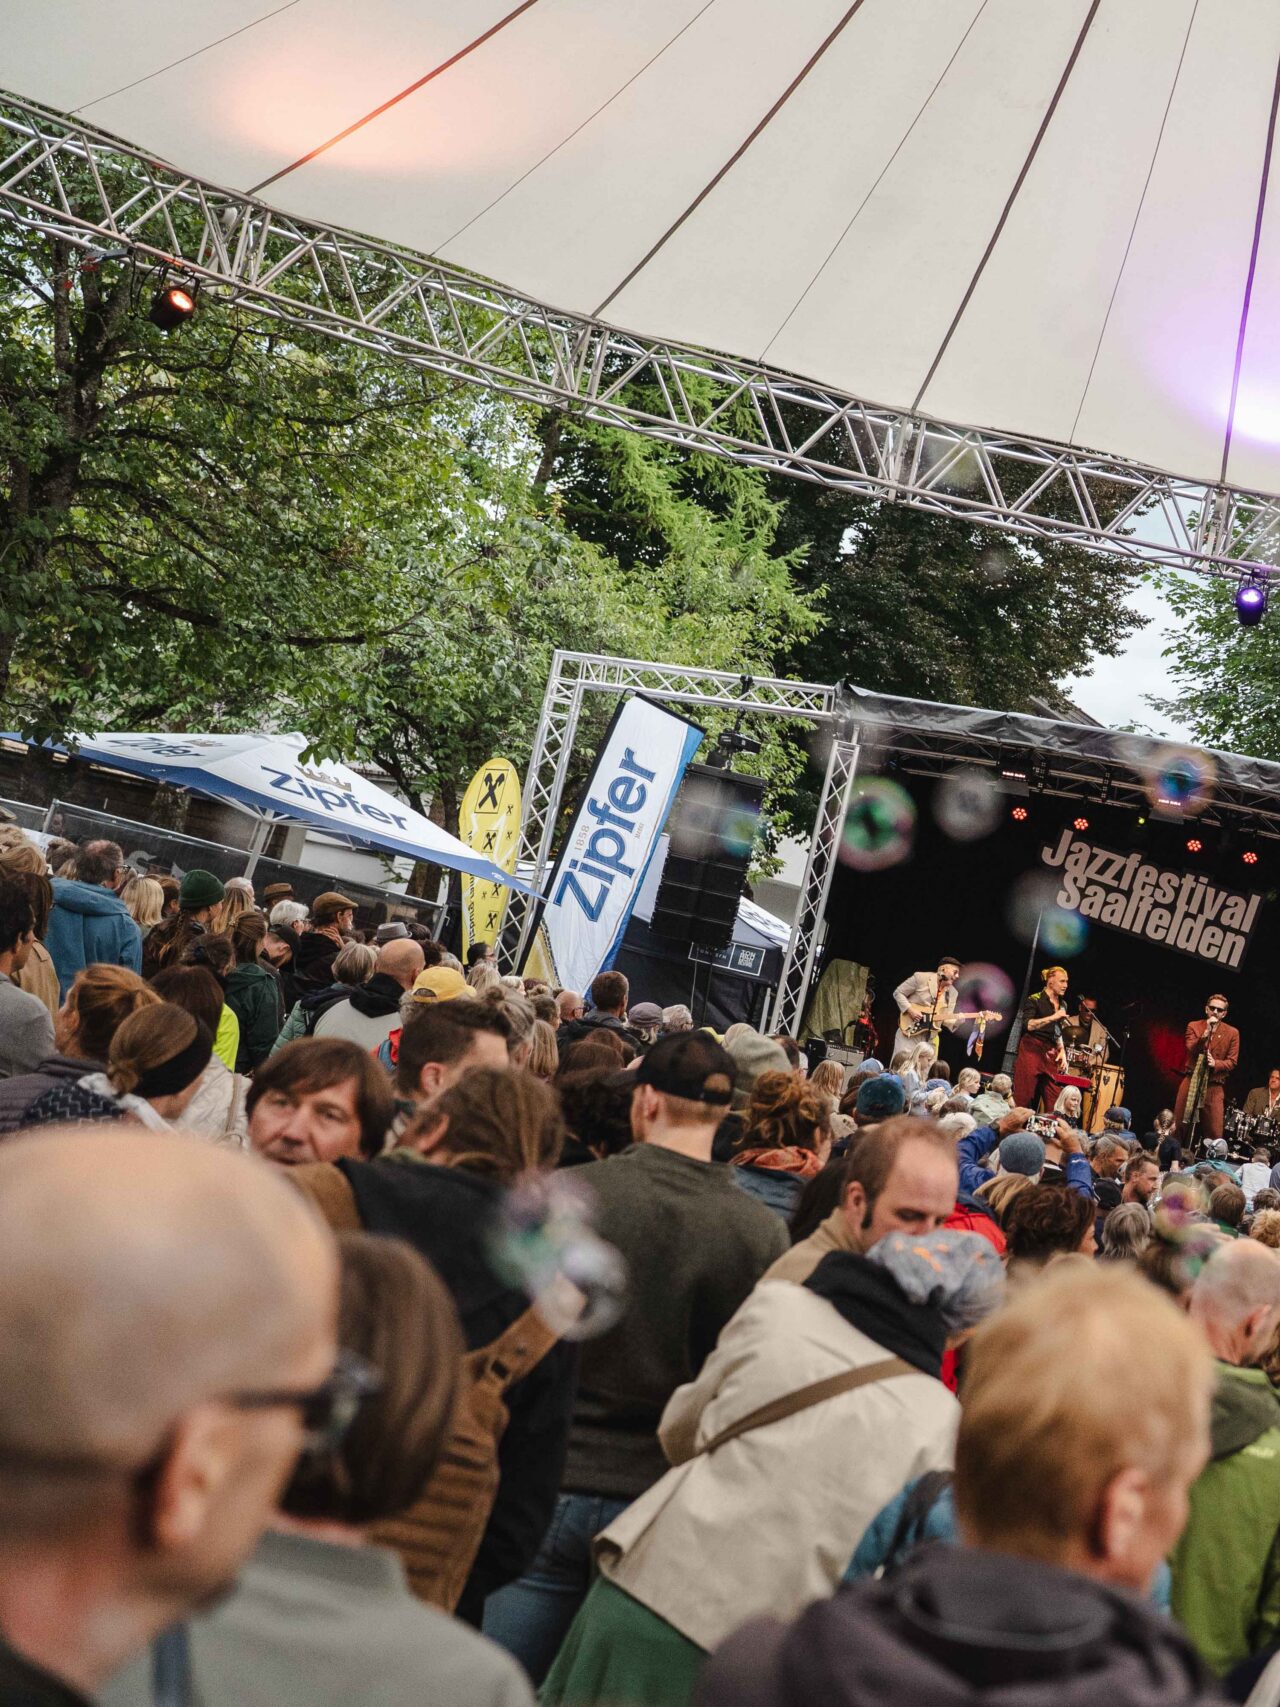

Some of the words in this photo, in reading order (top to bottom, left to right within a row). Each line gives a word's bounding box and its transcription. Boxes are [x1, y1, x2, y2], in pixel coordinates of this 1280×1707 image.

[260, 765, 408, 830] Zipfer
[552, 747, 656, 923] Zipfer
[574, 825, 589, 851] 1858
[1041, 829, 1261, 933] Jazzfestival
[1056, 871, 1246, 967] Saalfelden
